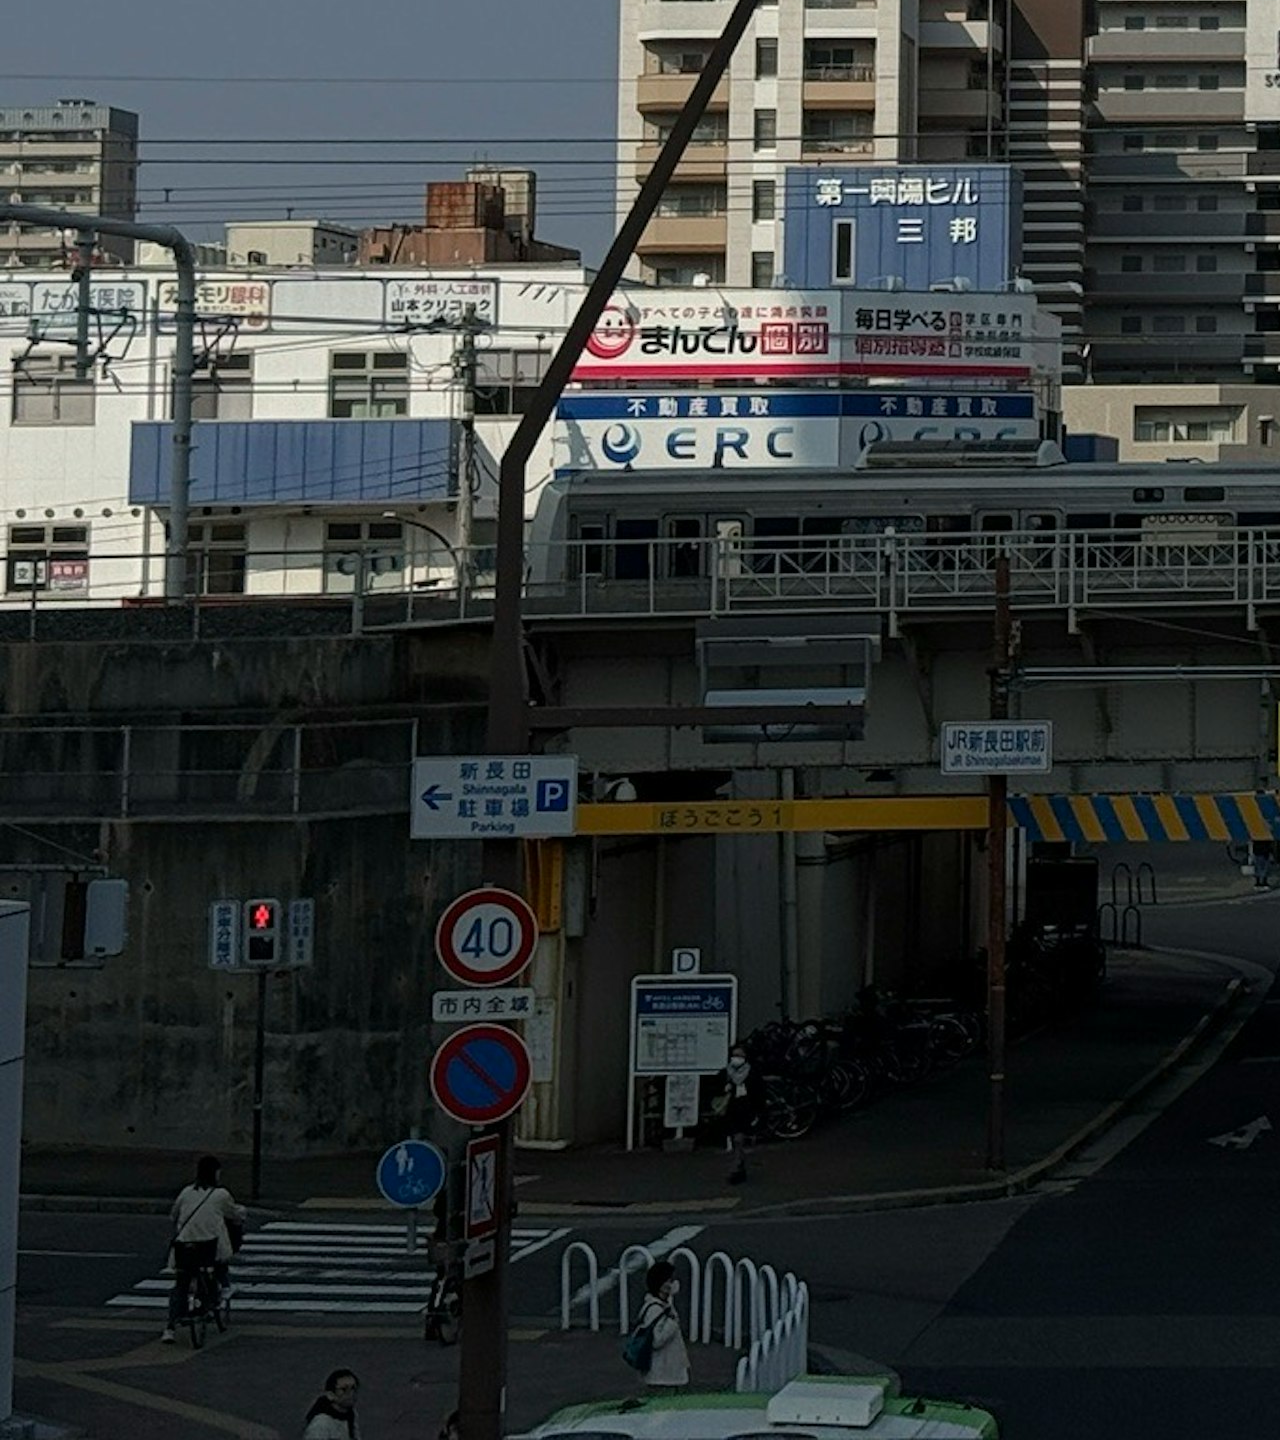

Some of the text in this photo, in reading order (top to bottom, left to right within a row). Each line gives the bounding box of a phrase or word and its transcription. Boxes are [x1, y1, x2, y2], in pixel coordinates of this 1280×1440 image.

[896, 217, 977, 243] 三邦
[391, 299, 491, 312] 山本クリニク
[855, 308, 946, 331] 毎日学べる
[627, 397, 770, 418] 不動産買取
[880, 396, 998, 417] 不動産買取
[666, 427, 794, 459] ERC
[948, 729, 1045, 752] JR新長田駅前
[460, 762, 531, 780] 新長田
[544, 781, 564, 808] P
[458, 798, 528, 818] 駐車場
[471, 821, 515, 834] Parking
[461, 917, 514, 958] 40
[677, 951, 696, 972] D
[440, 996, 528, 1014] 市内全域
